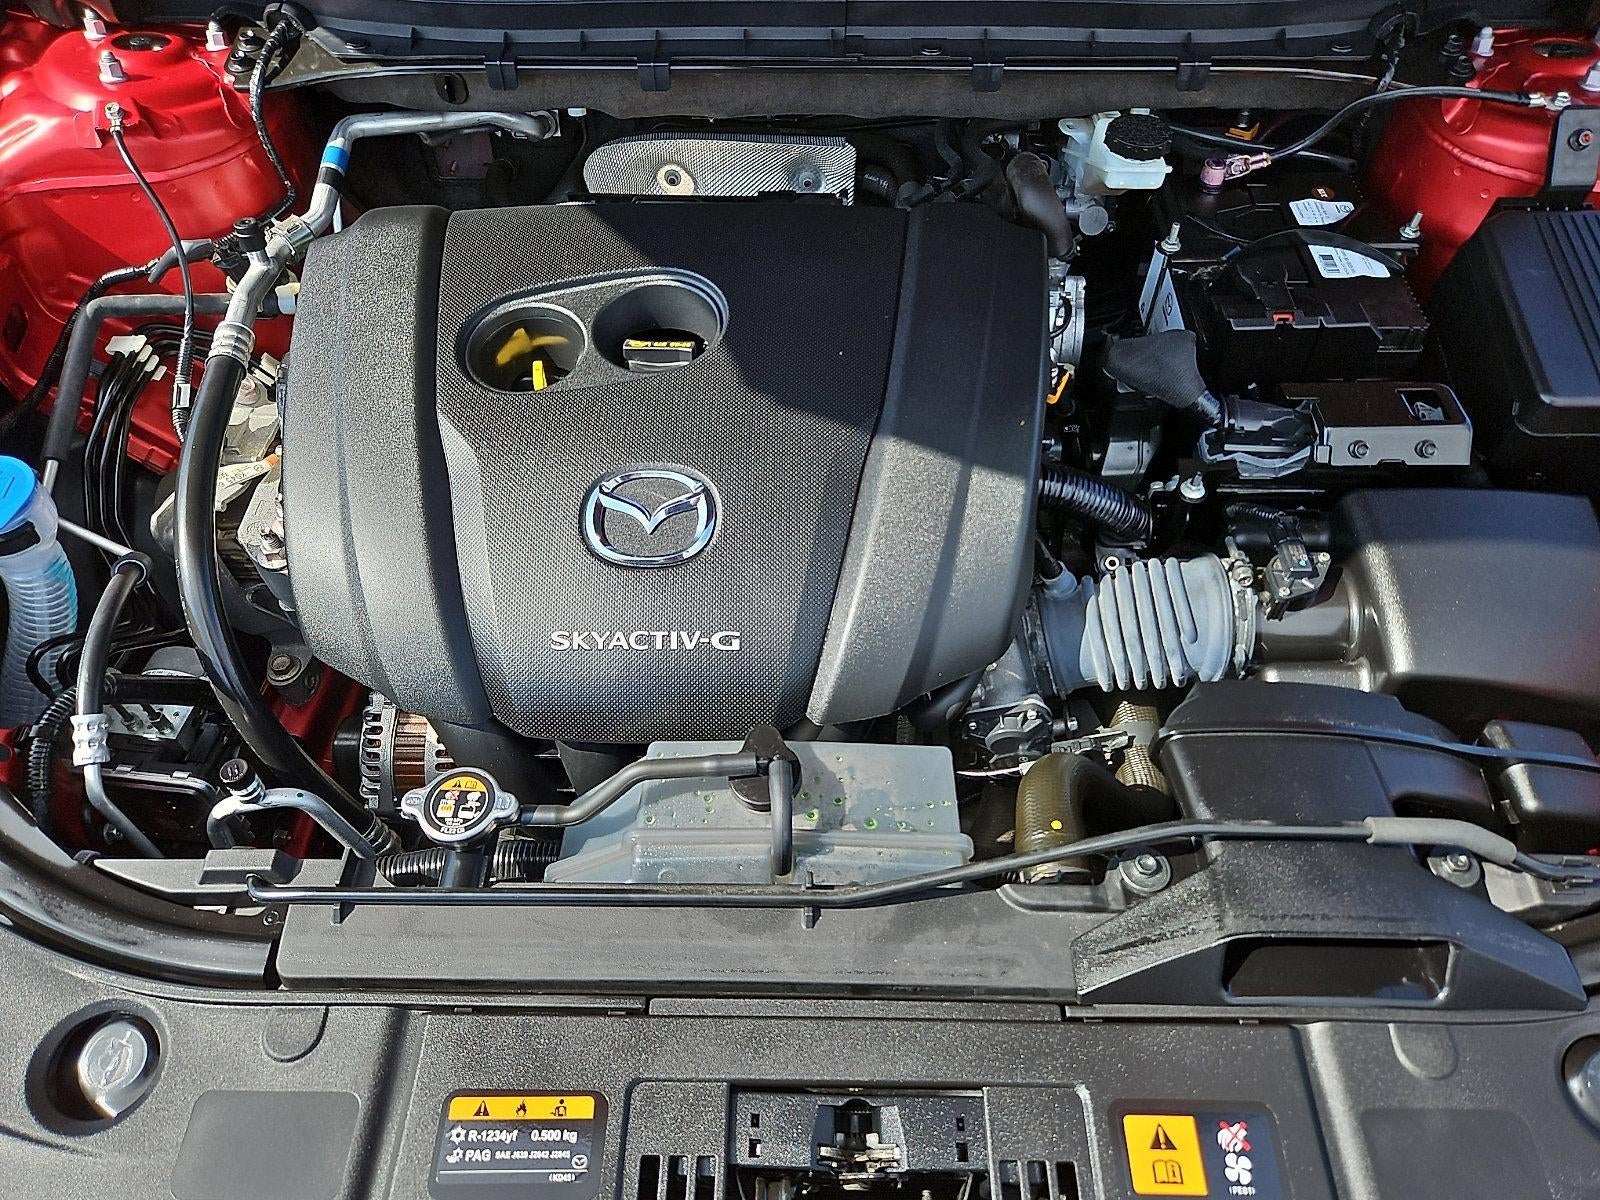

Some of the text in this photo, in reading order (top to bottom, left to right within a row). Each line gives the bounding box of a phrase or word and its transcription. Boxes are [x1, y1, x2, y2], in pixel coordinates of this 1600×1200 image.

[550, 630, 741, 650] SKYACTIV-G
[467, 1129, 577, 1143] R-1234yf 0.500 kg
[465, 1149, 491, 1162] PAG
